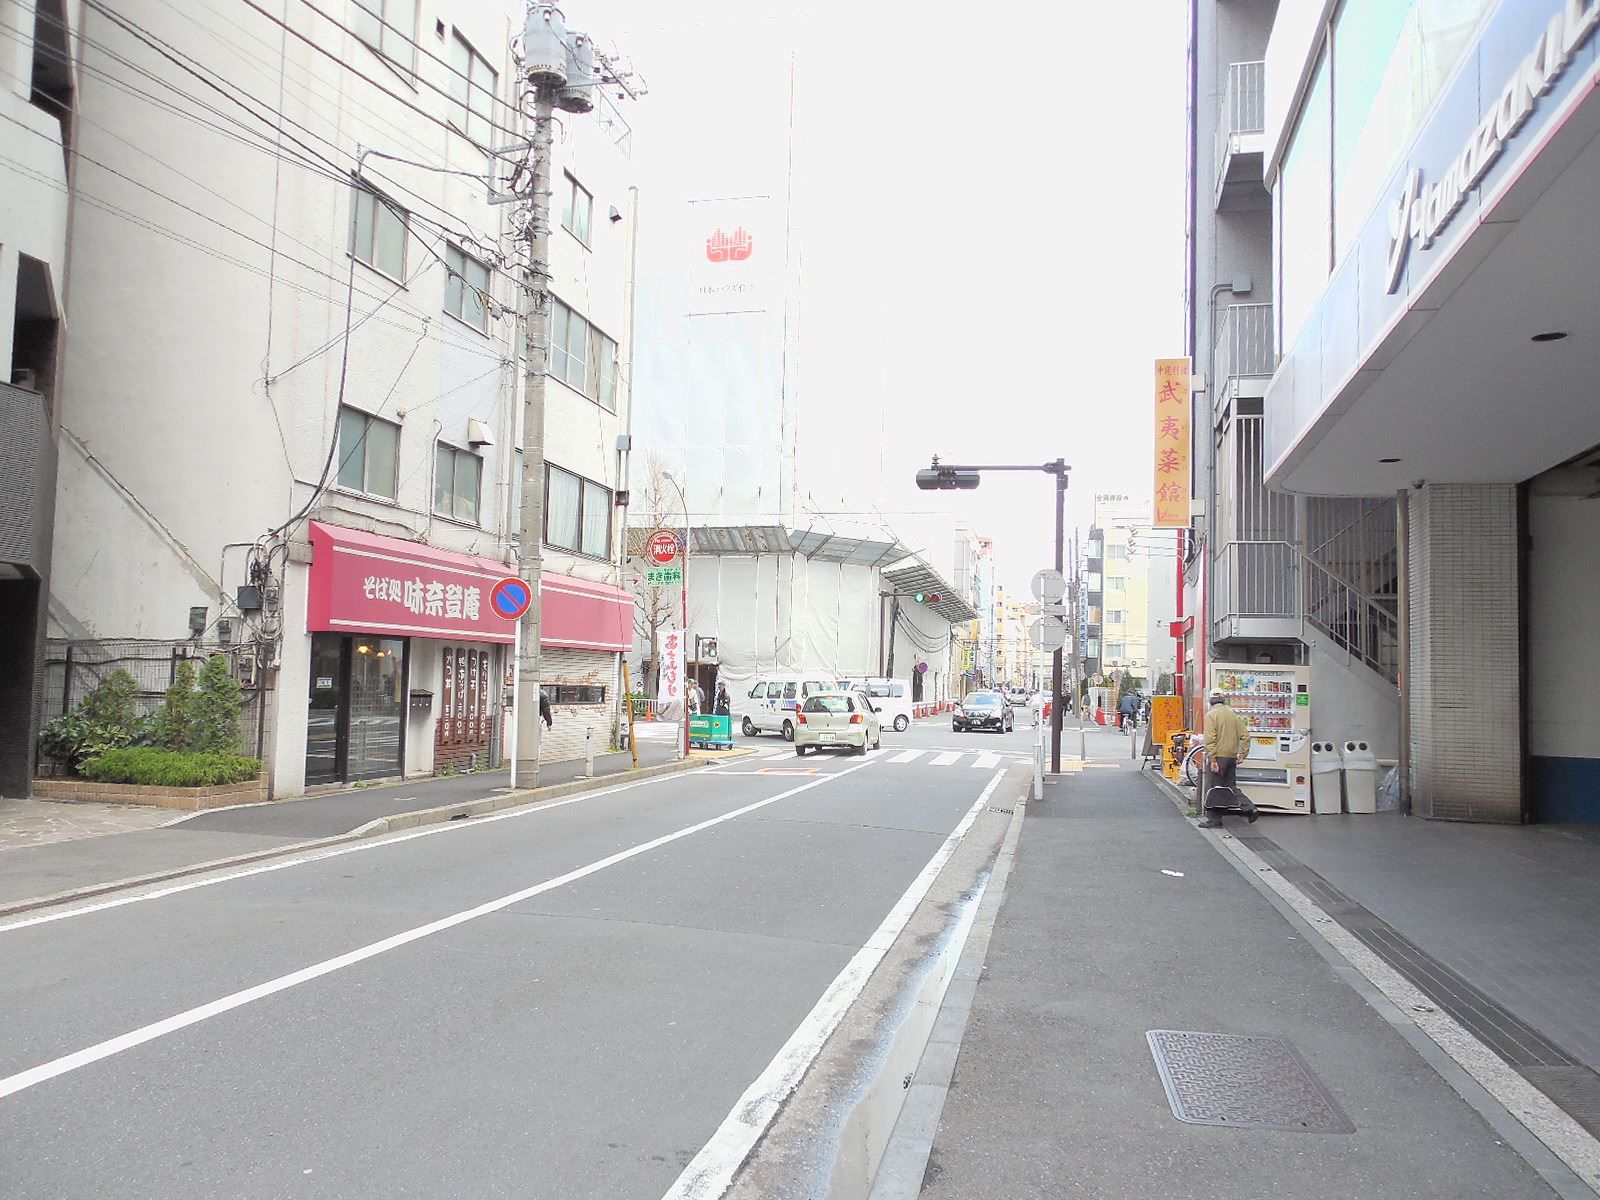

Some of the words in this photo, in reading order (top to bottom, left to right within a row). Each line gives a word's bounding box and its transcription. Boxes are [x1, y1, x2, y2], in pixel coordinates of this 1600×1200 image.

[653, 543, 675, 555] 消火栓
[648, 571, 681, 582] まき歯科
[363, 576, 402, 603] そば処
[403, 577, 481, 621] 味奈登庵
